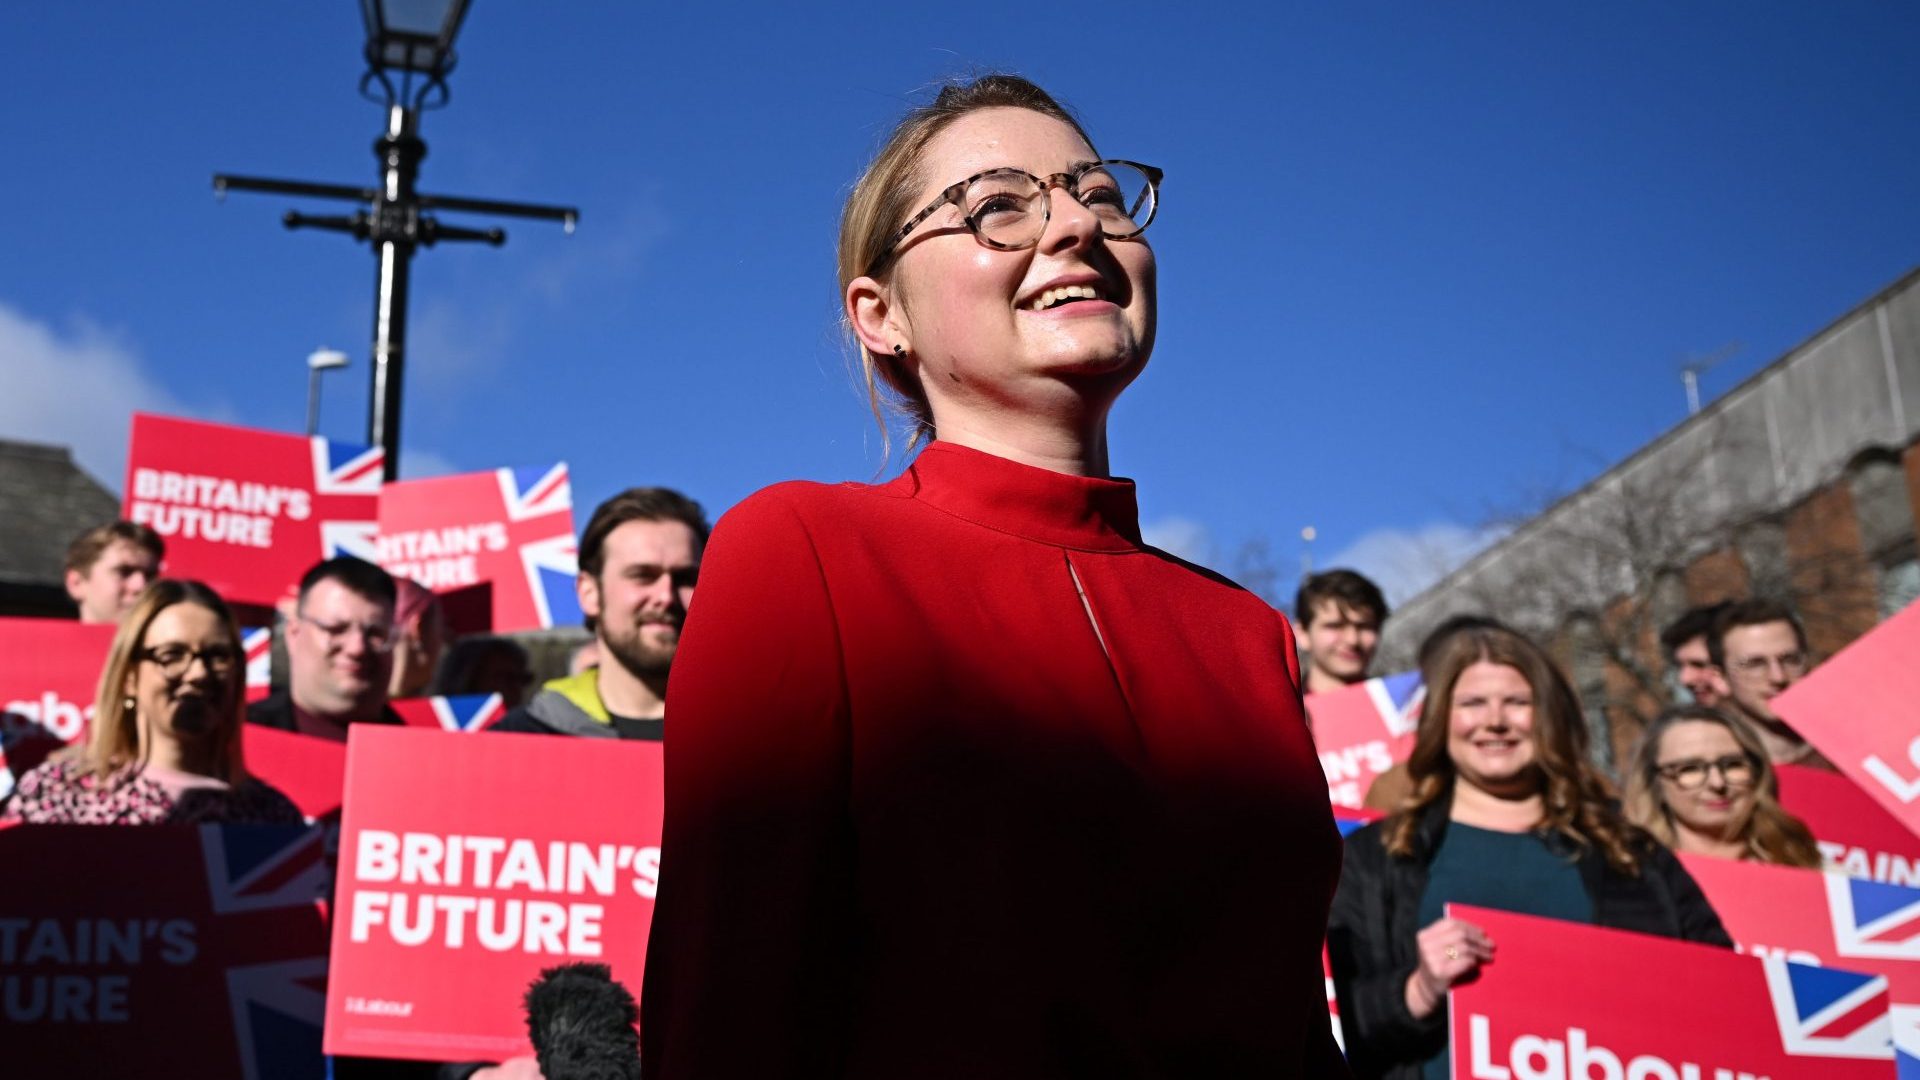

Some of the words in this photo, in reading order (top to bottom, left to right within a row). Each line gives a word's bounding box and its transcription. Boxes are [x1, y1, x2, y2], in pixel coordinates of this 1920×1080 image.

[134, 468, 311, 520] BRITAIN'S
[130, 502, 273, 548] FUTURE
[355, 829, 661, 899] BRITAIN'S
[351, 890, 604, 957] FUTURE
